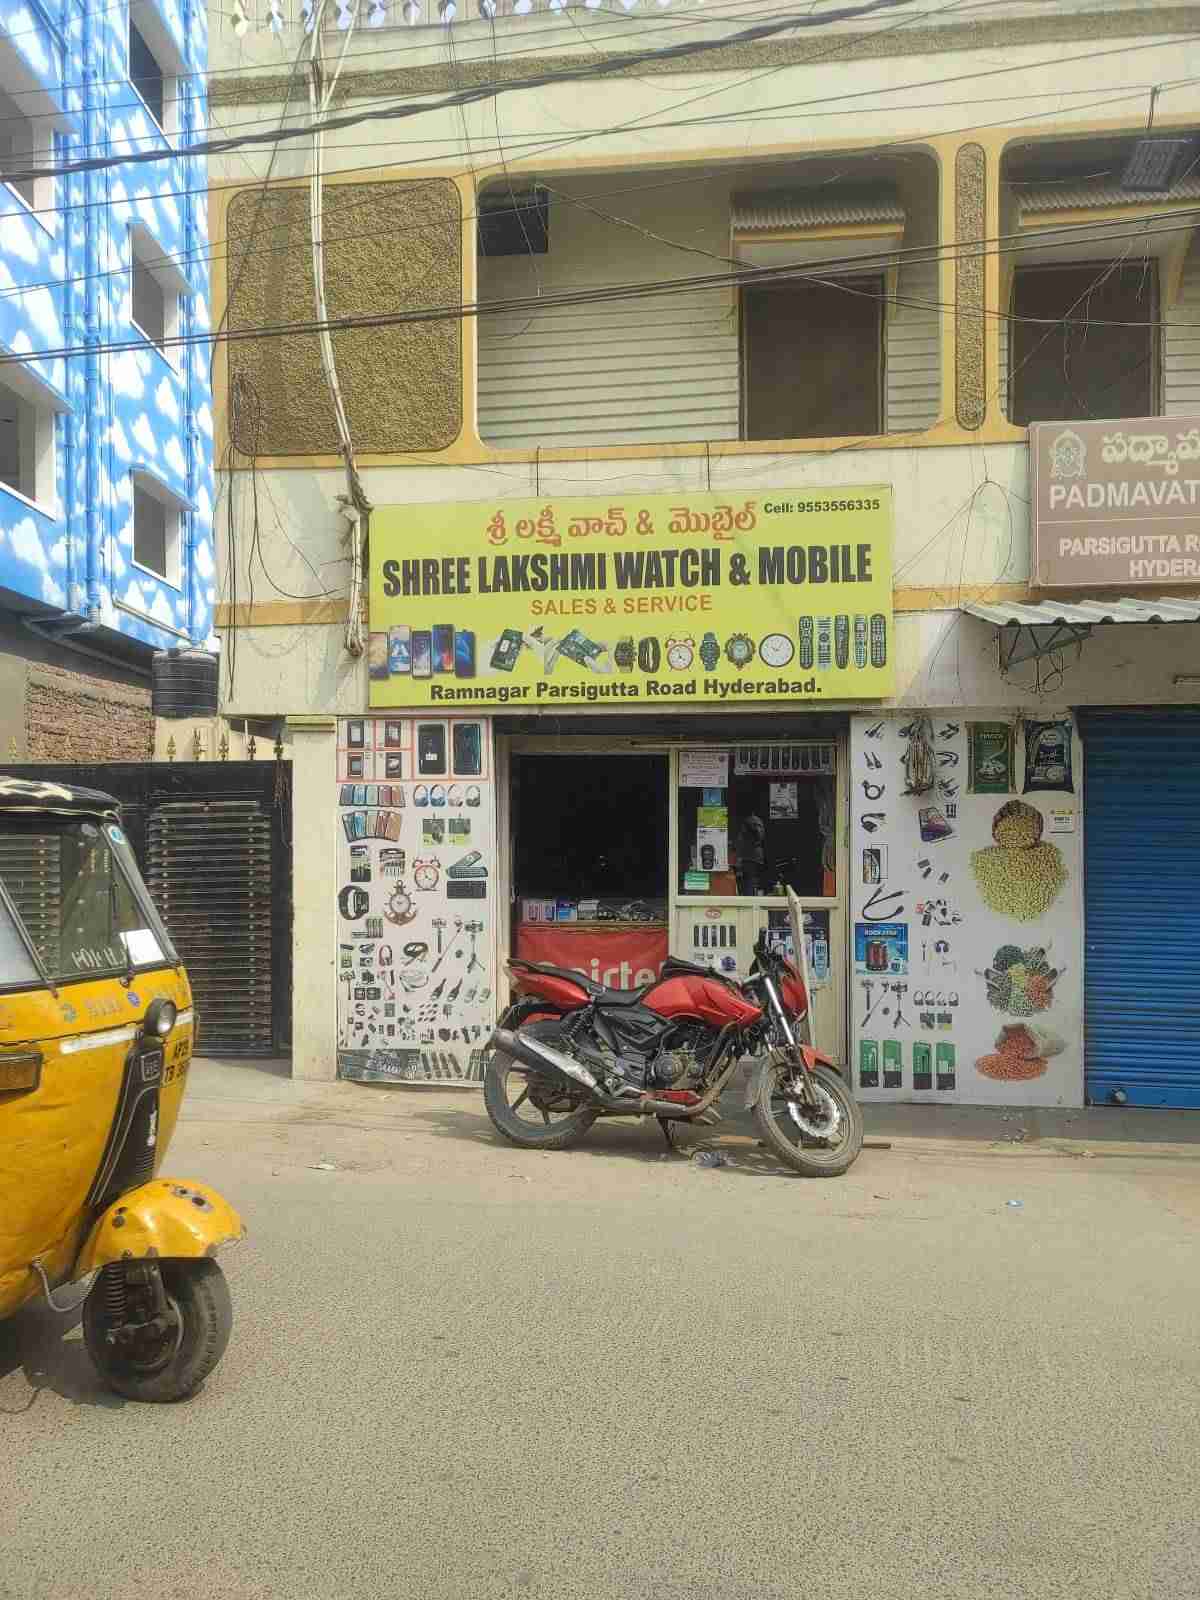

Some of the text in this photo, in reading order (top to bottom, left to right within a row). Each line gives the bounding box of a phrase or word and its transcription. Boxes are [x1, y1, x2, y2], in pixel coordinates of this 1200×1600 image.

[764, 499, 881, 514] Cell: 9553556335
[1050, 479, 1200, 510] PADMAVAT
[486, 510, 508, 546] శ్రీ
[568, 507, 627, 537] వాచ్
[636, 509, 654, 535] &
[668, 501, 757, 541] మొబైల్
[1059, 535, 1181, 556] PARSIGUTTA
[383, 543, 873, 597] SHREE LAKSHMI WATCH & MOBILE
[531, 594, 713, 615] SALES & SERVICE
[430, 677, 822, 702] Ramnagar Parsigutta Road Hyderabad.
[571, 958, 668, 992] irte
